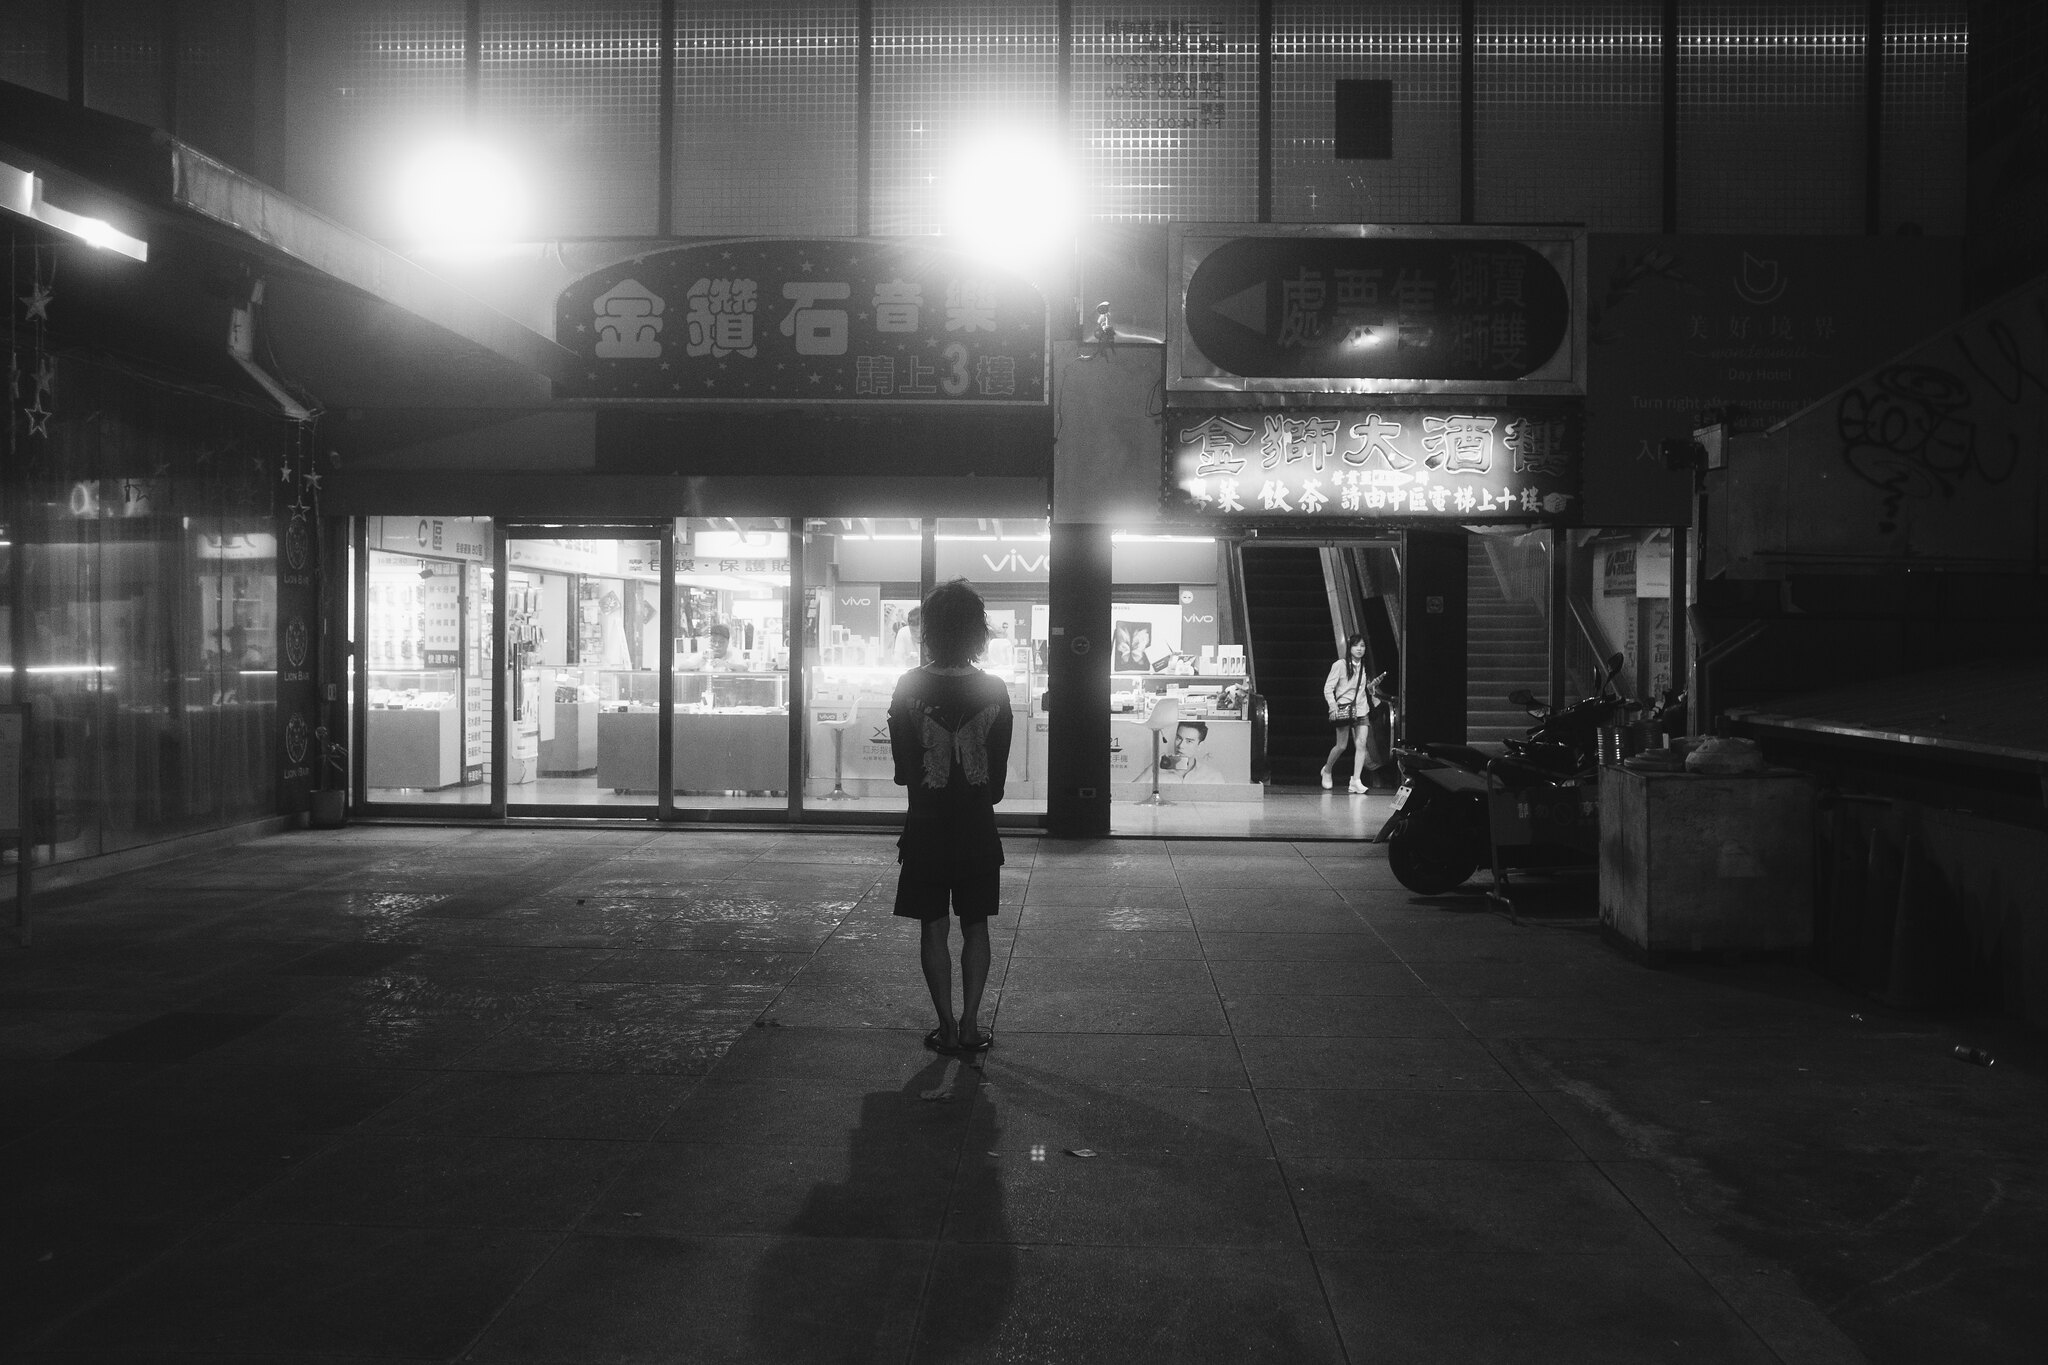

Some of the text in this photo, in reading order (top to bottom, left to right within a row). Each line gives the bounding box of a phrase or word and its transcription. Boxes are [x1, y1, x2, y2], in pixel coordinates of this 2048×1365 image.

[855, 342, 1016, 397] 請上3樓
[1728, 368, 1792, 383] Day Hotel
[1632, 396, 1663, 409] Turn
[1667, 396, 1700, 413] right
[1180, 412, 1570, 474] 金獅大酒樓
[1257, 479, 1329, 514] 飲茶
[841, 596, 871, 606] vivo
[1183, 613, 1213, 623] vivo
